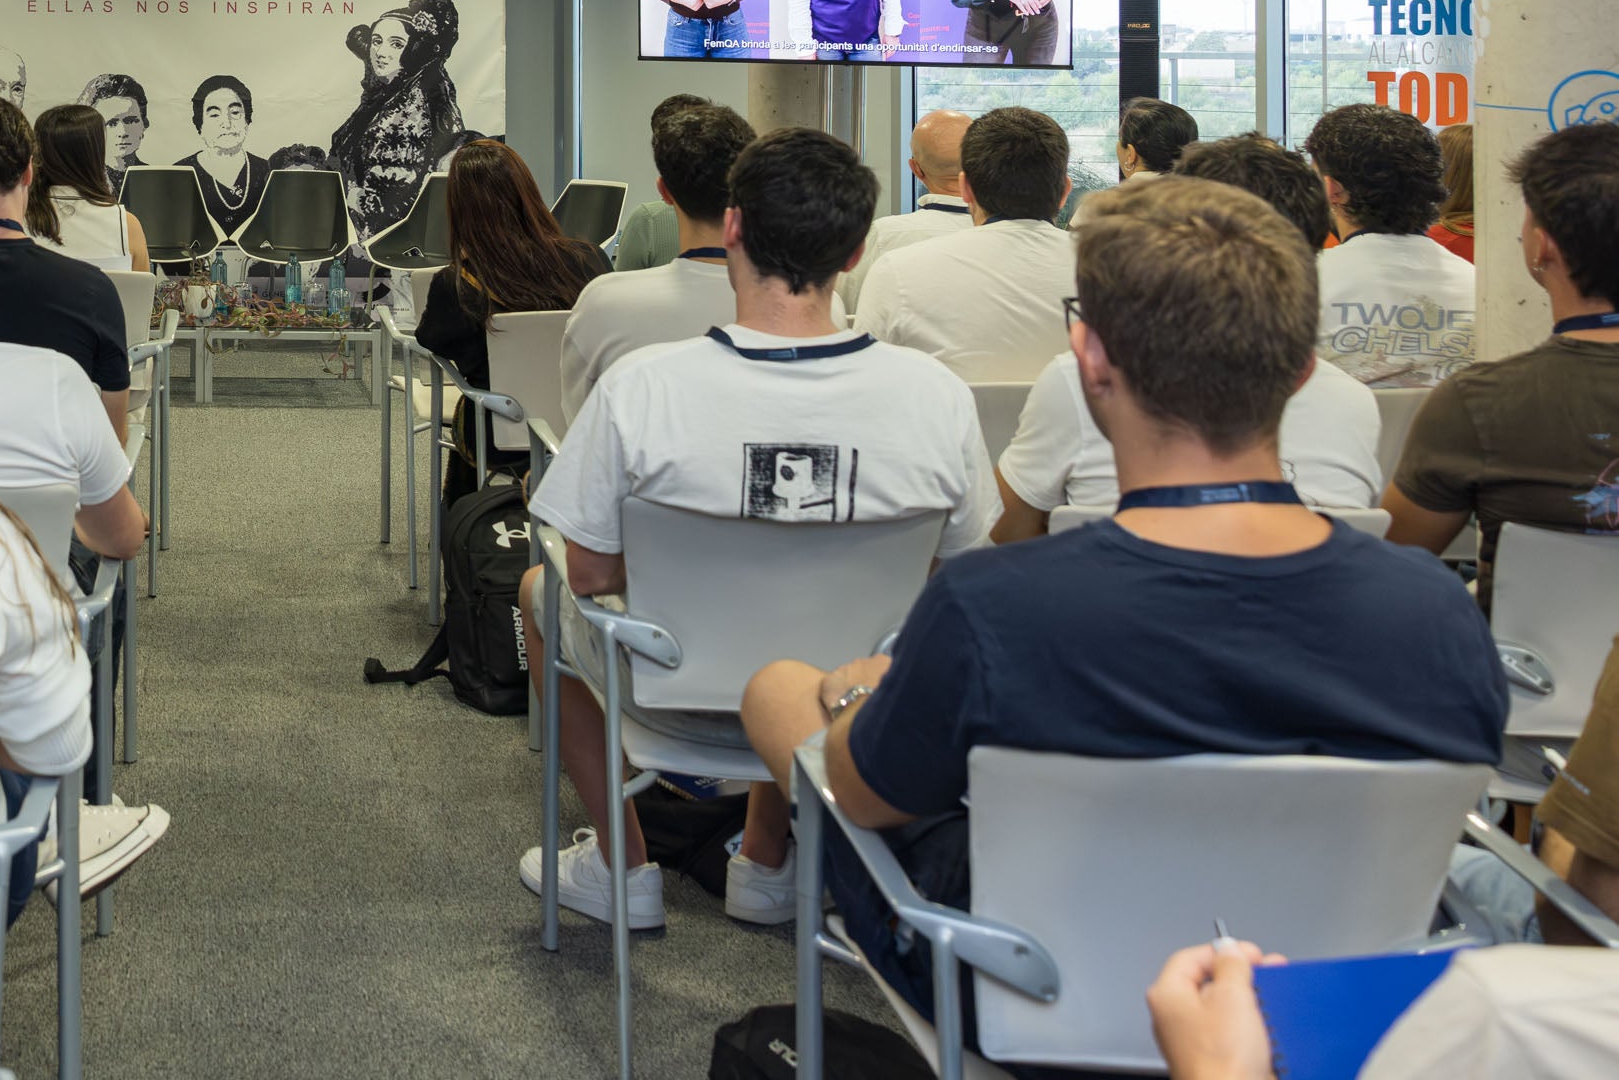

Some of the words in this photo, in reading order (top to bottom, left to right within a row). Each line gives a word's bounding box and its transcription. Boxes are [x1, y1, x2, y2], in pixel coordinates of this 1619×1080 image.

[27, 0, 113, 13] ELLAS
[136, 0, 190, 14] NOS
[213, 1, 355, 15] INSPIRAN
[704, 38, 740, 49] FemQA
[741, 39, 771, 50] brinda
[798, 40, 854, 52] participants
[855, 43, 874, 52] una
[876, 42, 929, 54] oportunitat
[931, 43, 999, 54] d'endinsar-se
[1368, 41, 1392, 65] AL
[511, 605, 529, 672] ARMOUR
